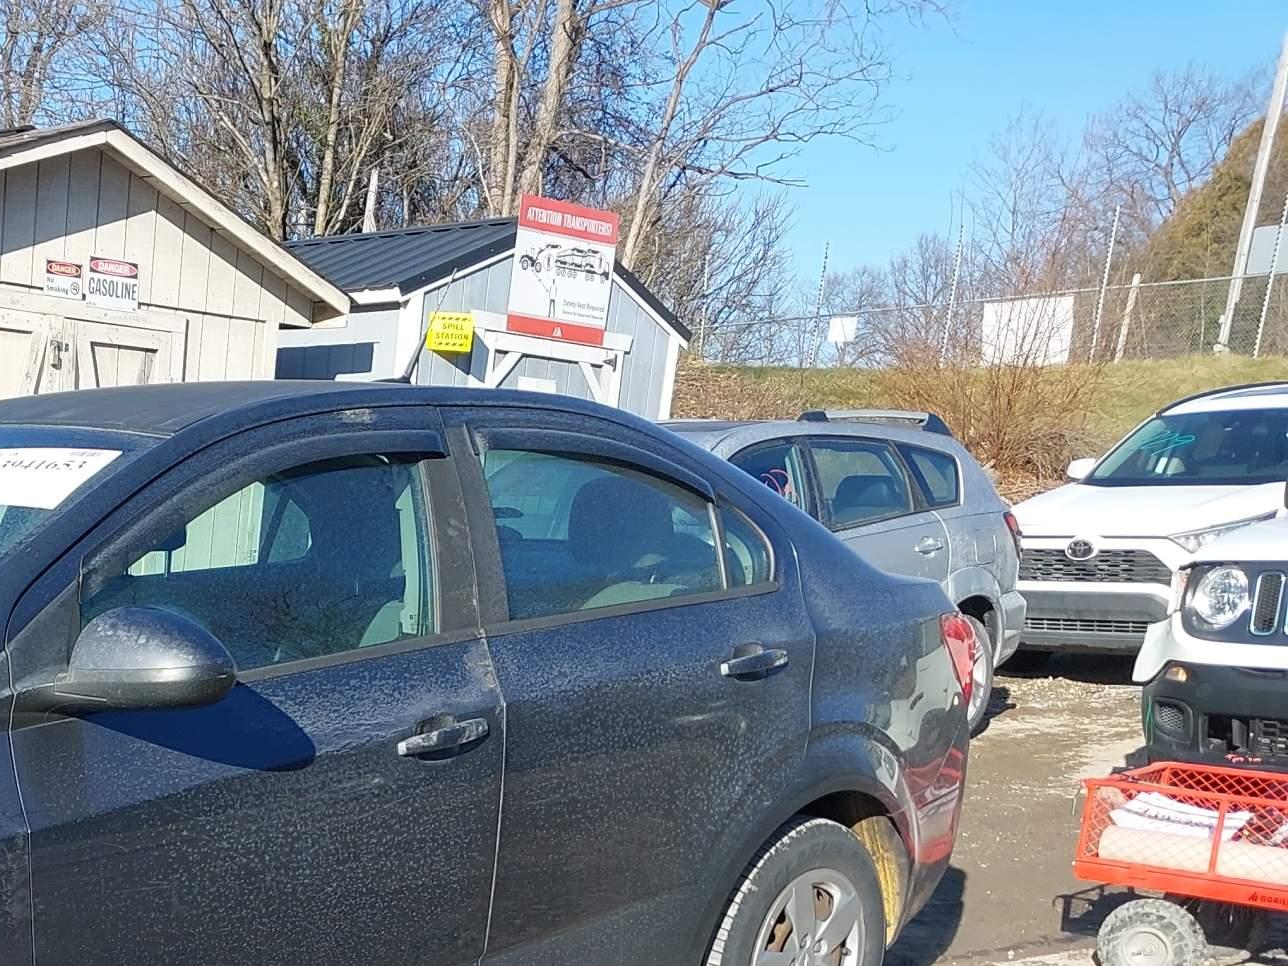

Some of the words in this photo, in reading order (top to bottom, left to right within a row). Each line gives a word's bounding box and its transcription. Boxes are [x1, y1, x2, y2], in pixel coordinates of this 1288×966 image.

[527, 207, 562, 226] ATTENTION
[563, 213, 613, 236] TRANSPORTERS!
[51, 263, 77, 274] DANGER
[98, 261, 130, 275] DANGER
[88, 277, 137, 301] GASOLINE
[435, 332, 469, 341] STATION
